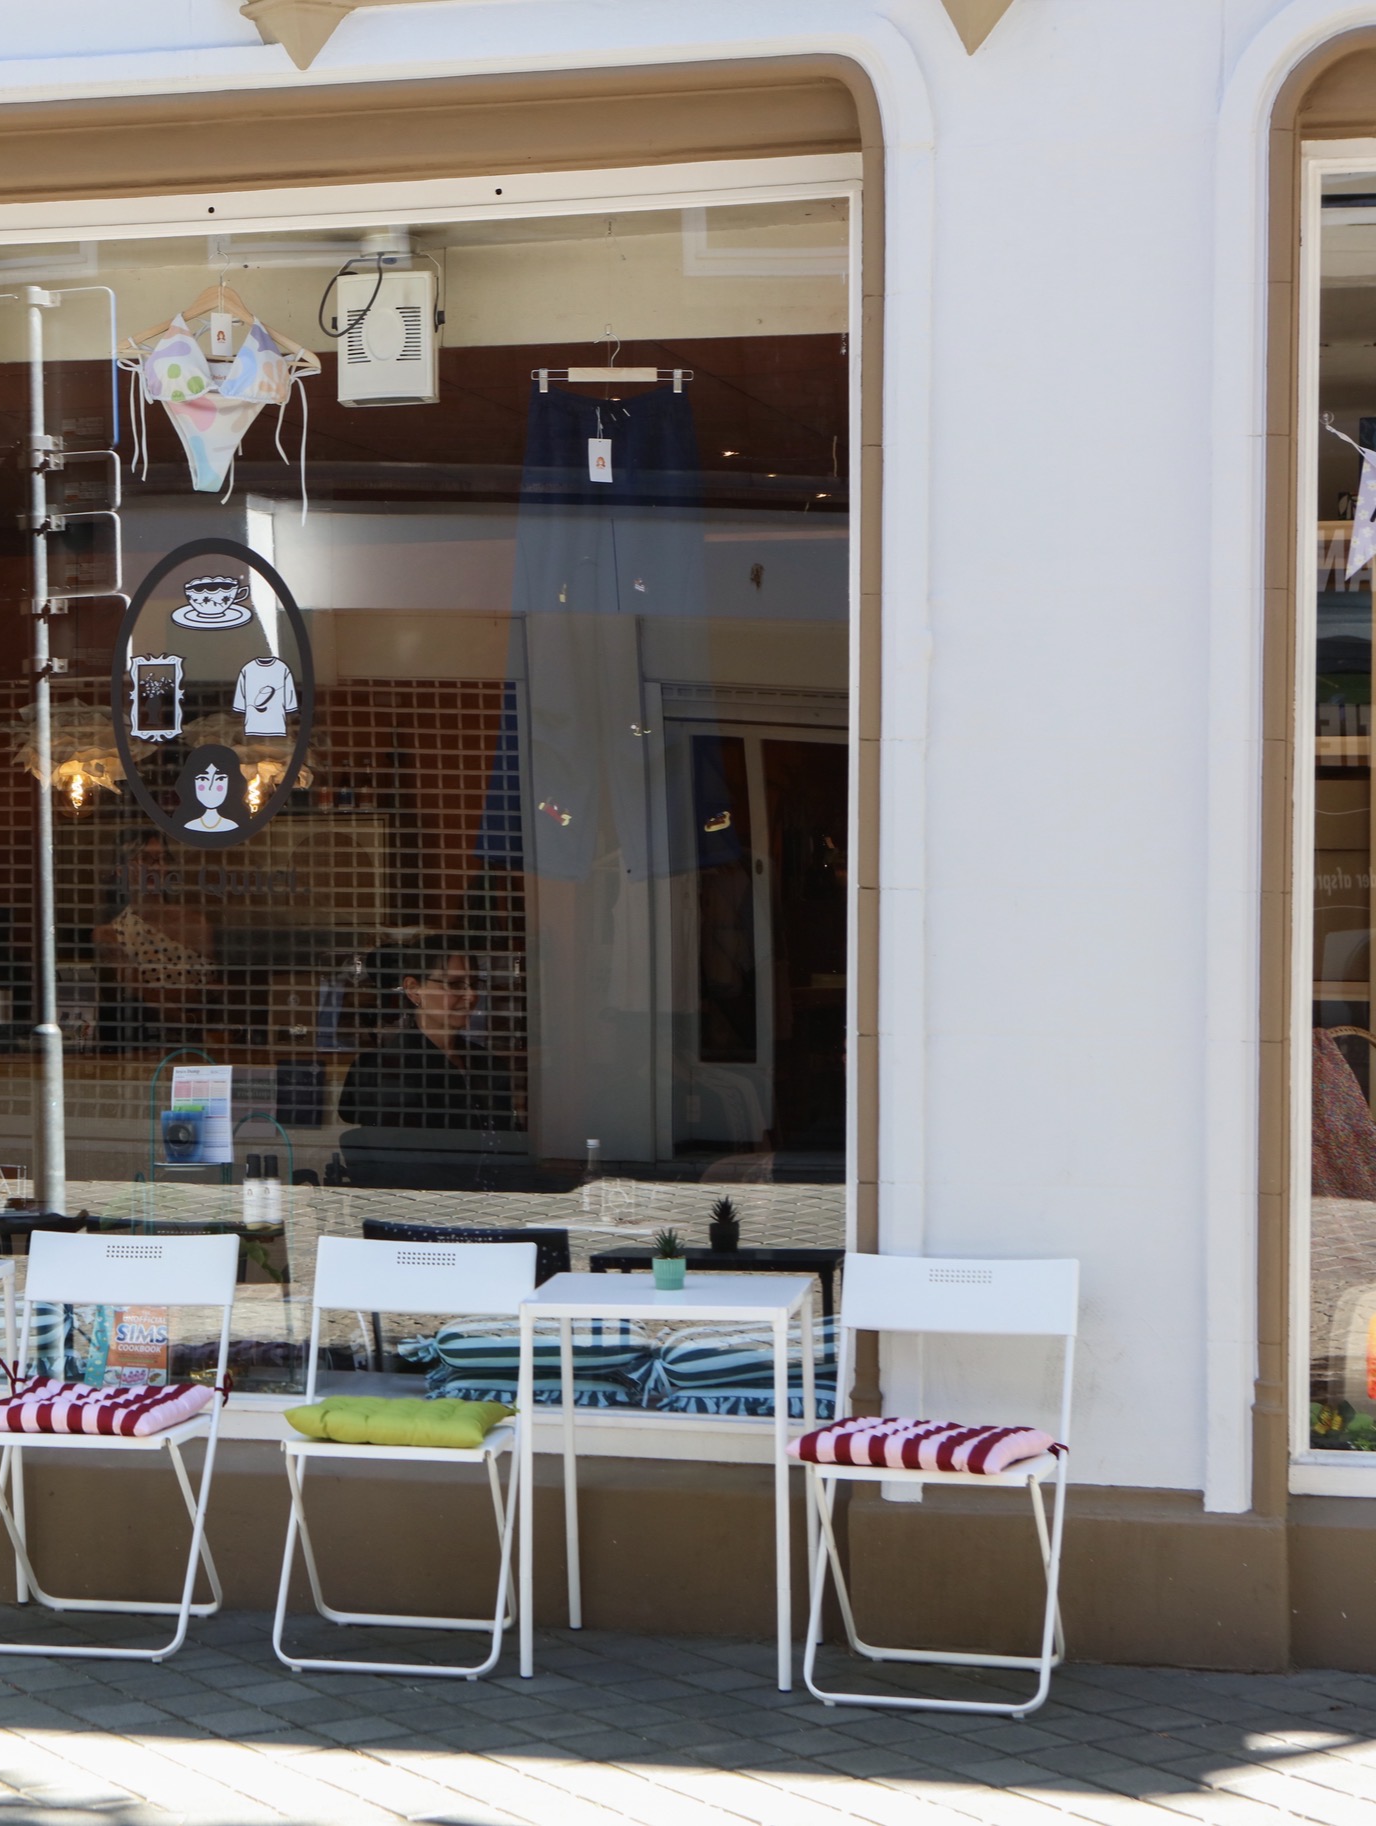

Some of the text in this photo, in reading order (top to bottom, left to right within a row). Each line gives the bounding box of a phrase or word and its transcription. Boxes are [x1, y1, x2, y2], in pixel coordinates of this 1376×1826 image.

[114, 863, 182, 896] The
[116, 1323, 167, 1344] SIMS
[118, 1344, 161, 1352] COOKBOOK
